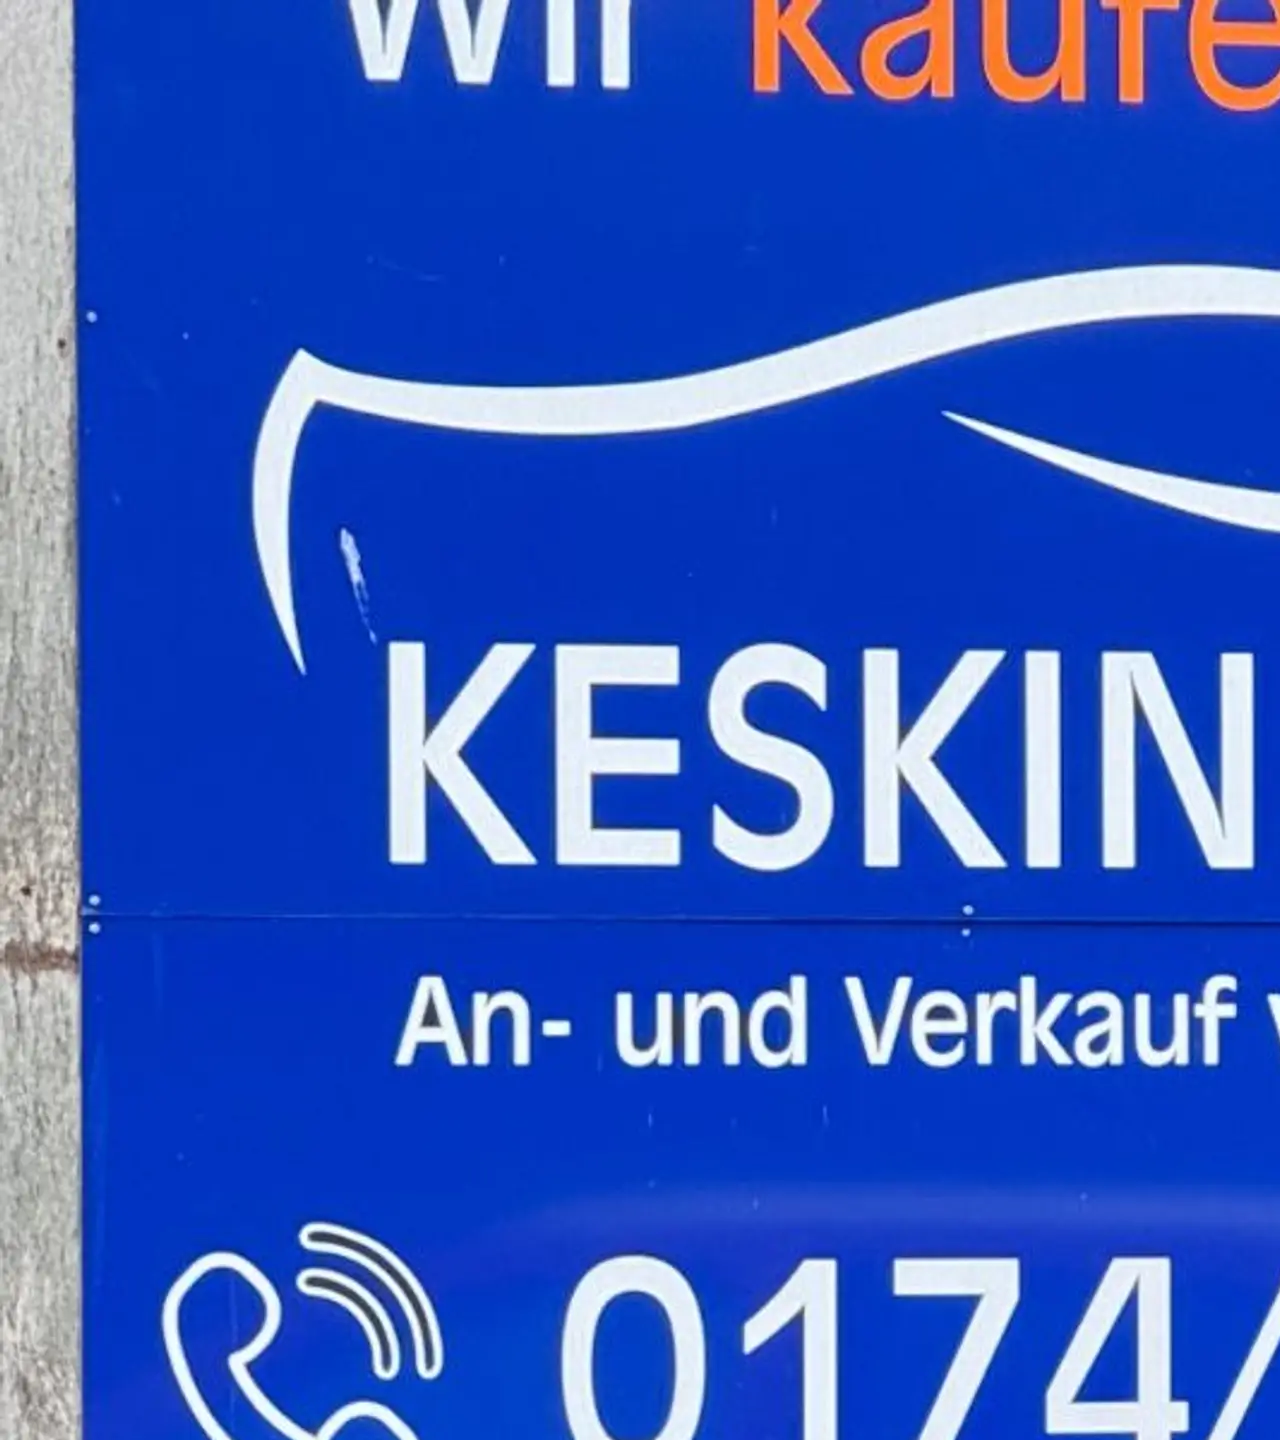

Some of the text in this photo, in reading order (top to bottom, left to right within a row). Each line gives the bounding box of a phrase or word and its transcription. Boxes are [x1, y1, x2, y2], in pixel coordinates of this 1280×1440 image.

[388, 641, 1255, 871] KESKIN
[395, 975, 571, 1067] An-
[615, 975, 807, 1068] und
[844, 974, 1238, 1069] Verkauf
